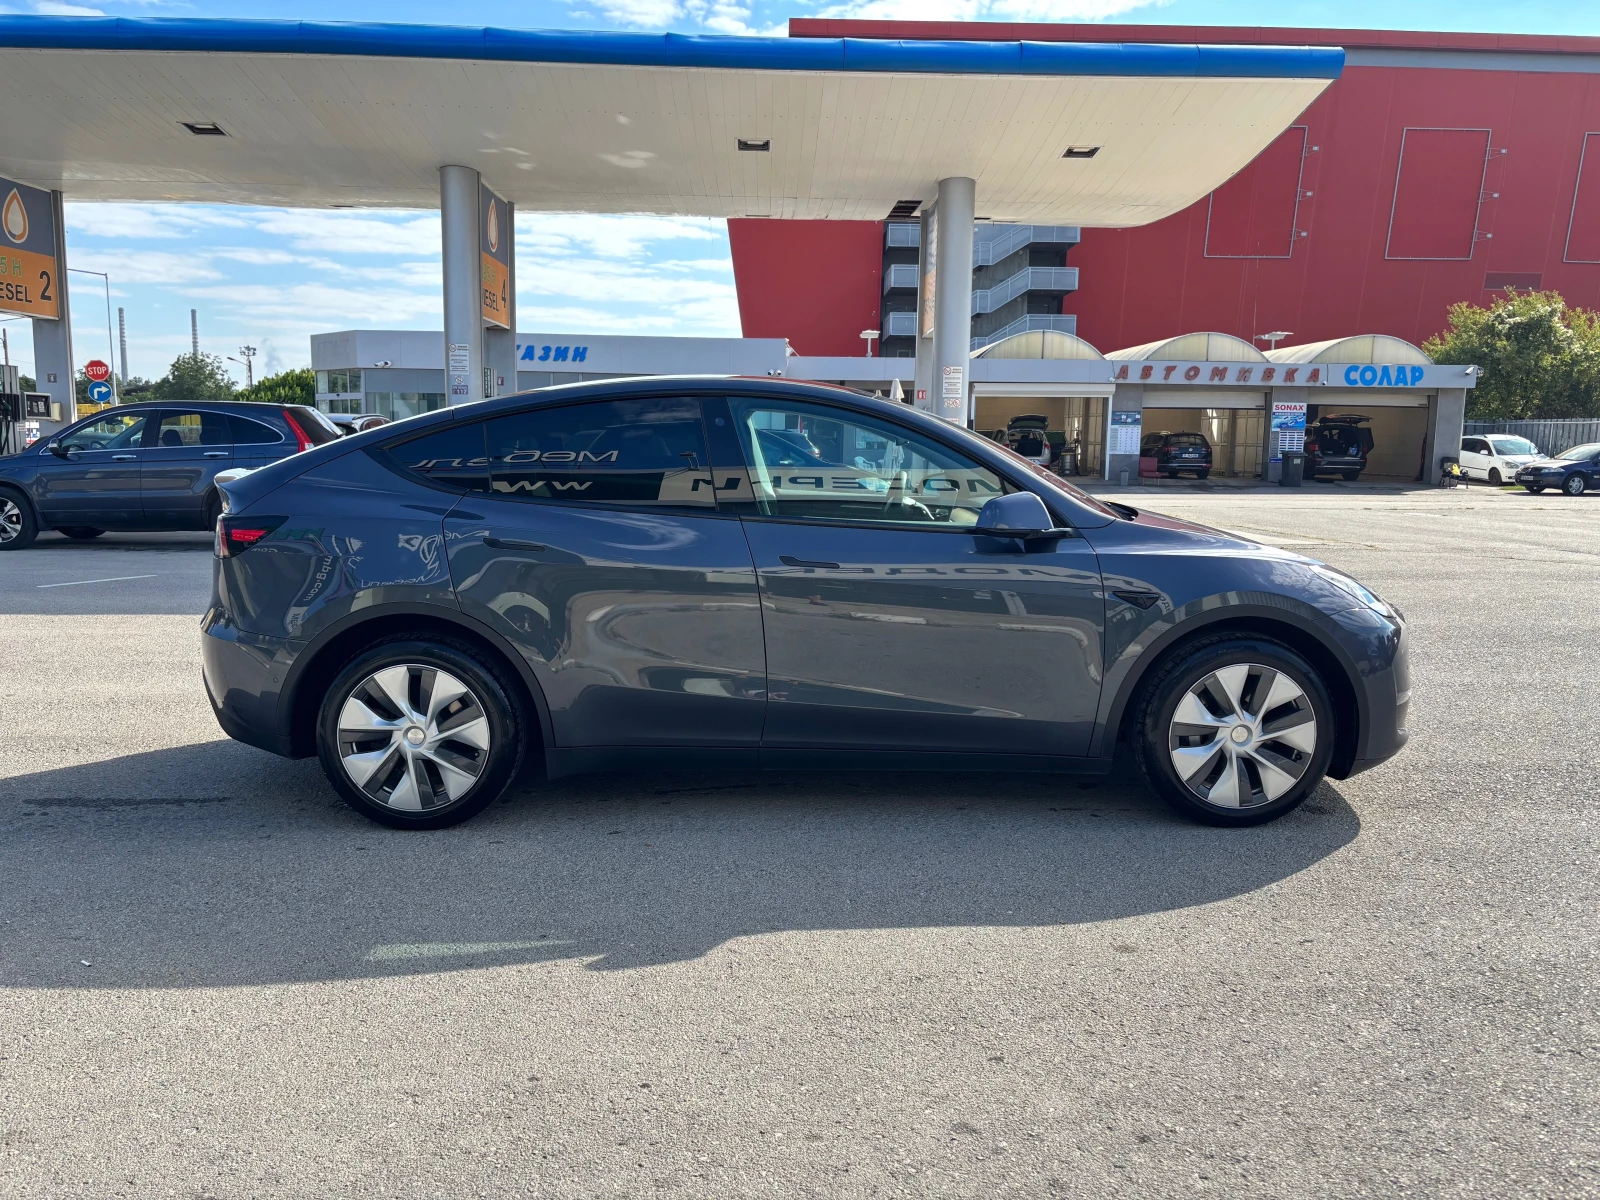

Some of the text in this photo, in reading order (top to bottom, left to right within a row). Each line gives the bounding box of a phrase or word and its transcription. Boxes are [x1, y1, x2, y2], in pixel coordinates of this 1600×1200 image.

[39, 270, 52, 301] 2
[501, 278, 507, 309] 4
[516, 344, 588, 362] АЗИН
[87, 366, 107, 375] STOP
[1115, 364, 1321, 383] АВТОМИВКА
[1344, 364, 1424, 386] СОЛАР
